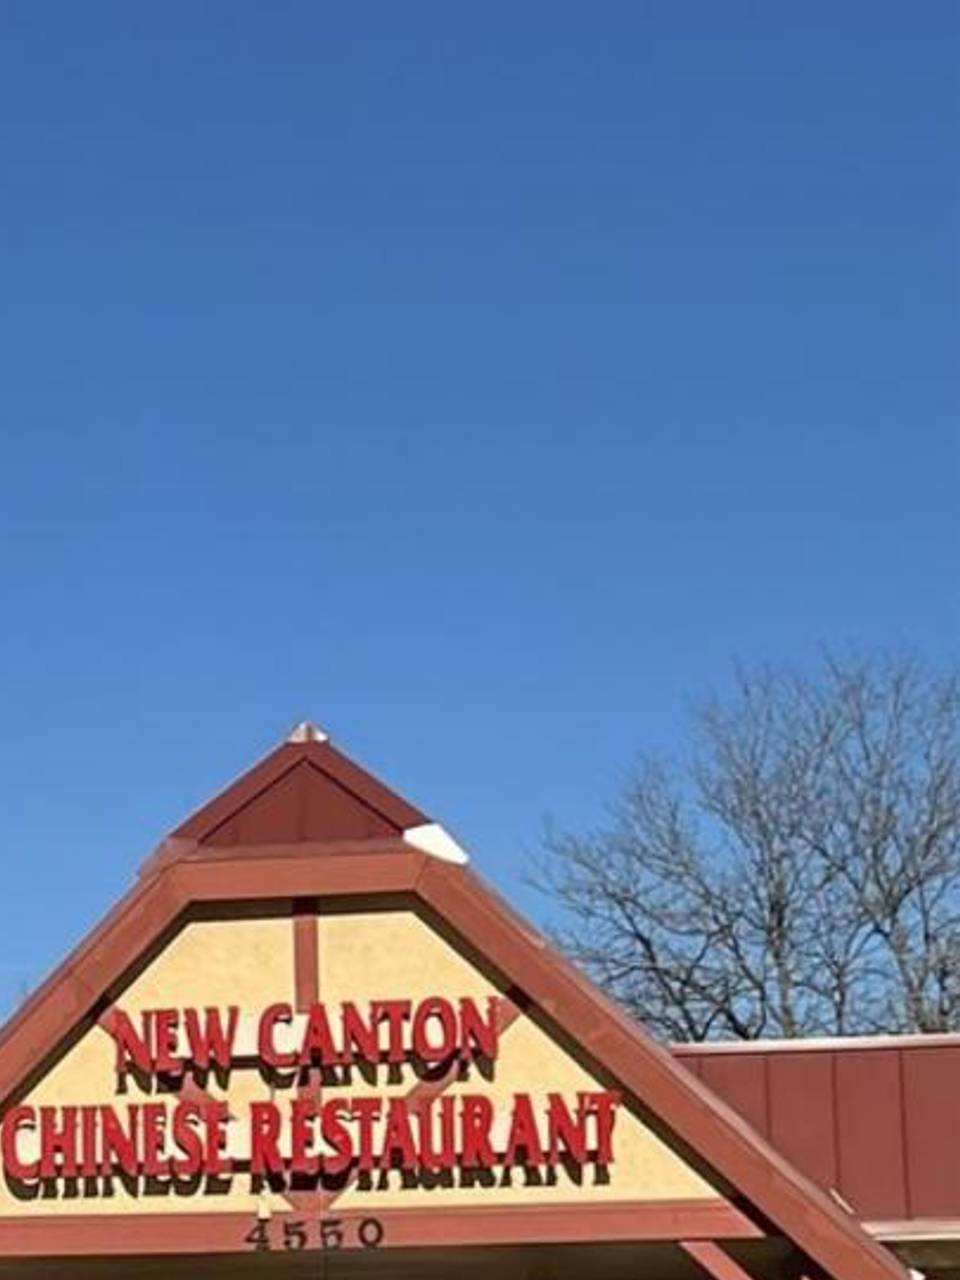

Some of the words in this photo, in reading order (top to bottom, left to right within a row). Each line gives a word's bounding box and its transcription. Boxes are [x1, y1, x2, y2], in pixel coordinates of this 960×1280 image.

[114, 1006, 240, 1076] NEW
[257, 996, 501, 1066] CANTON
[1, 1103, 234, 1180] CHINESE
[249, 1090, 622, 1176] RESTAURANT
[245, 1217, 384, 1250] 4550
